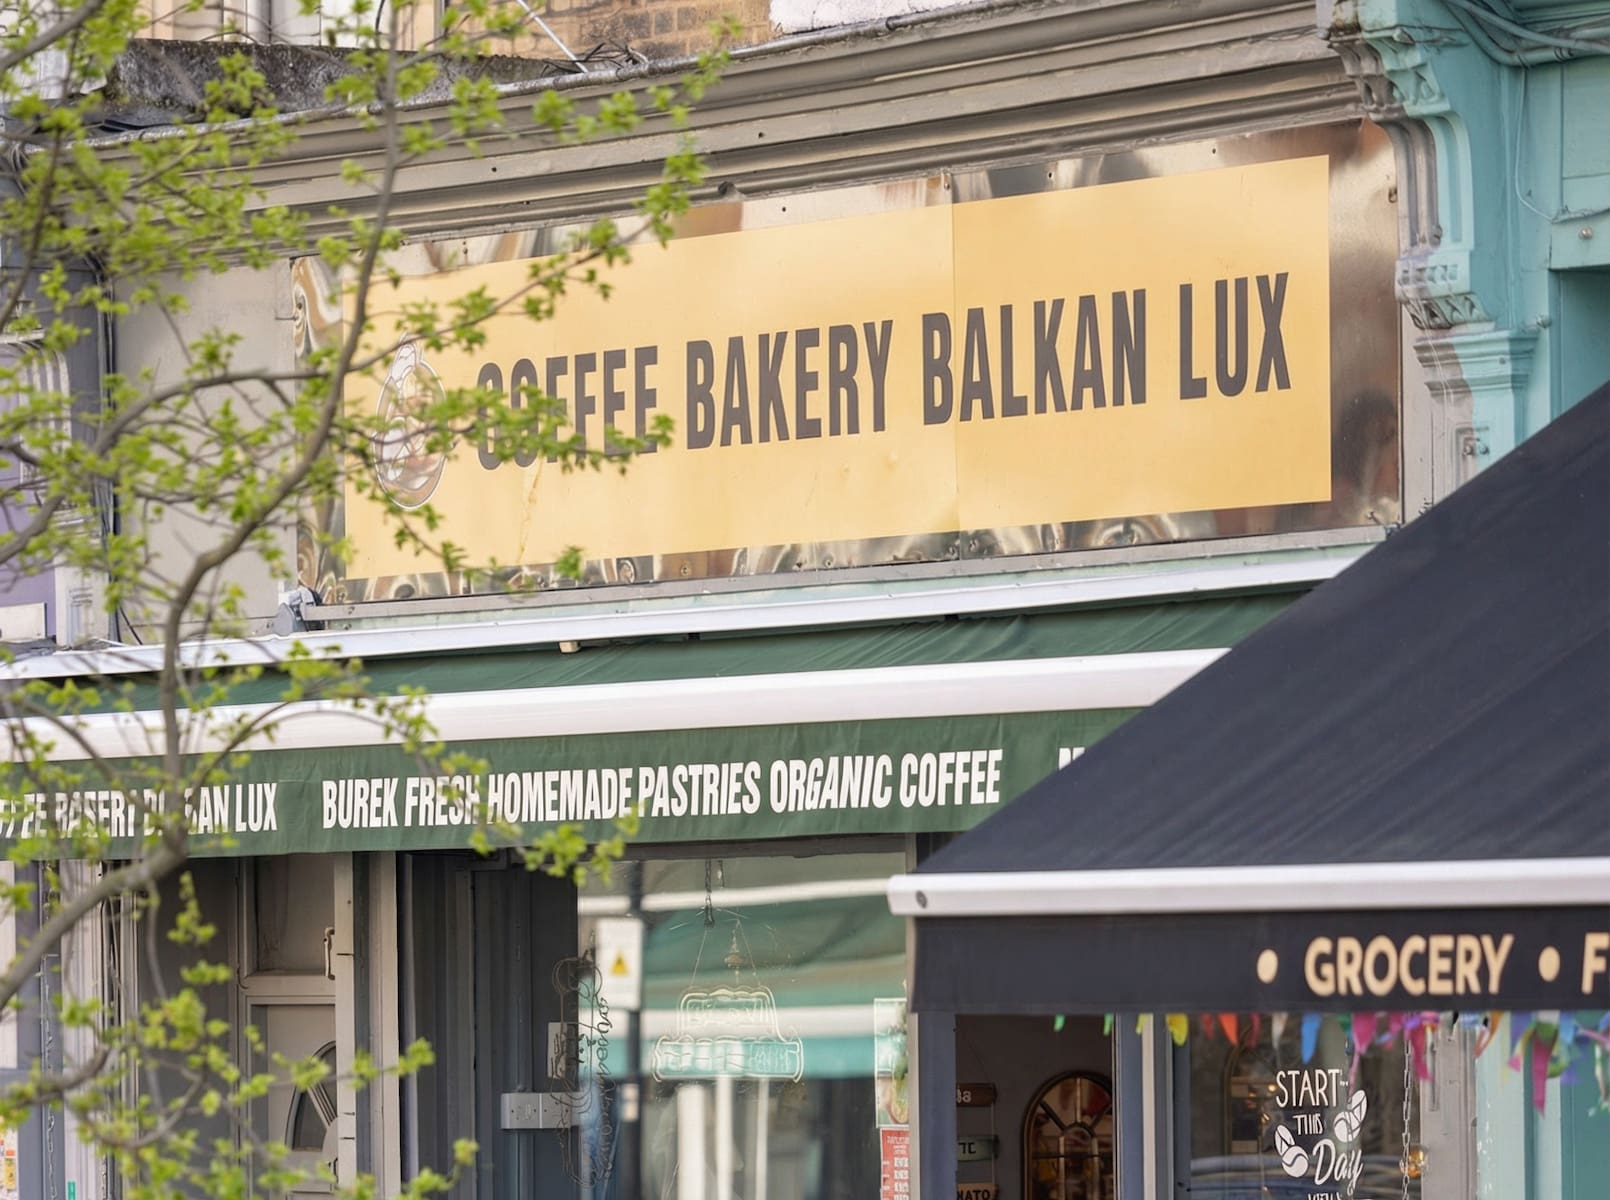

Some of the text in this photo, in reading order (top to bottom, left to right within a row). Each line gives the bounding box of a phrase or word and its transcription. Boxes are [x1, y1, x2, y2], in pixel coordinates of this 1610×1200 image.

[477, 272, 1292, 470] COFFEE BAKERY BALKAN LUX
[235, 782, 278, 832] LUX
[322, 777, 399, 829] BUREK
[404, 774, 480, 827] FRESH
[487, 767, 633, 824] HOMEMADE
[638, 760, 761, 817] PASTRIES
[769, 753, 892, 814] ORGANIC
[899, 748, 1003, 808] COFFEE
[1304, 934, 1515, 996] GROCERY
[1275, 1068, 1341, 1108] START
[1312, 1138, 1364, 1190] Day
